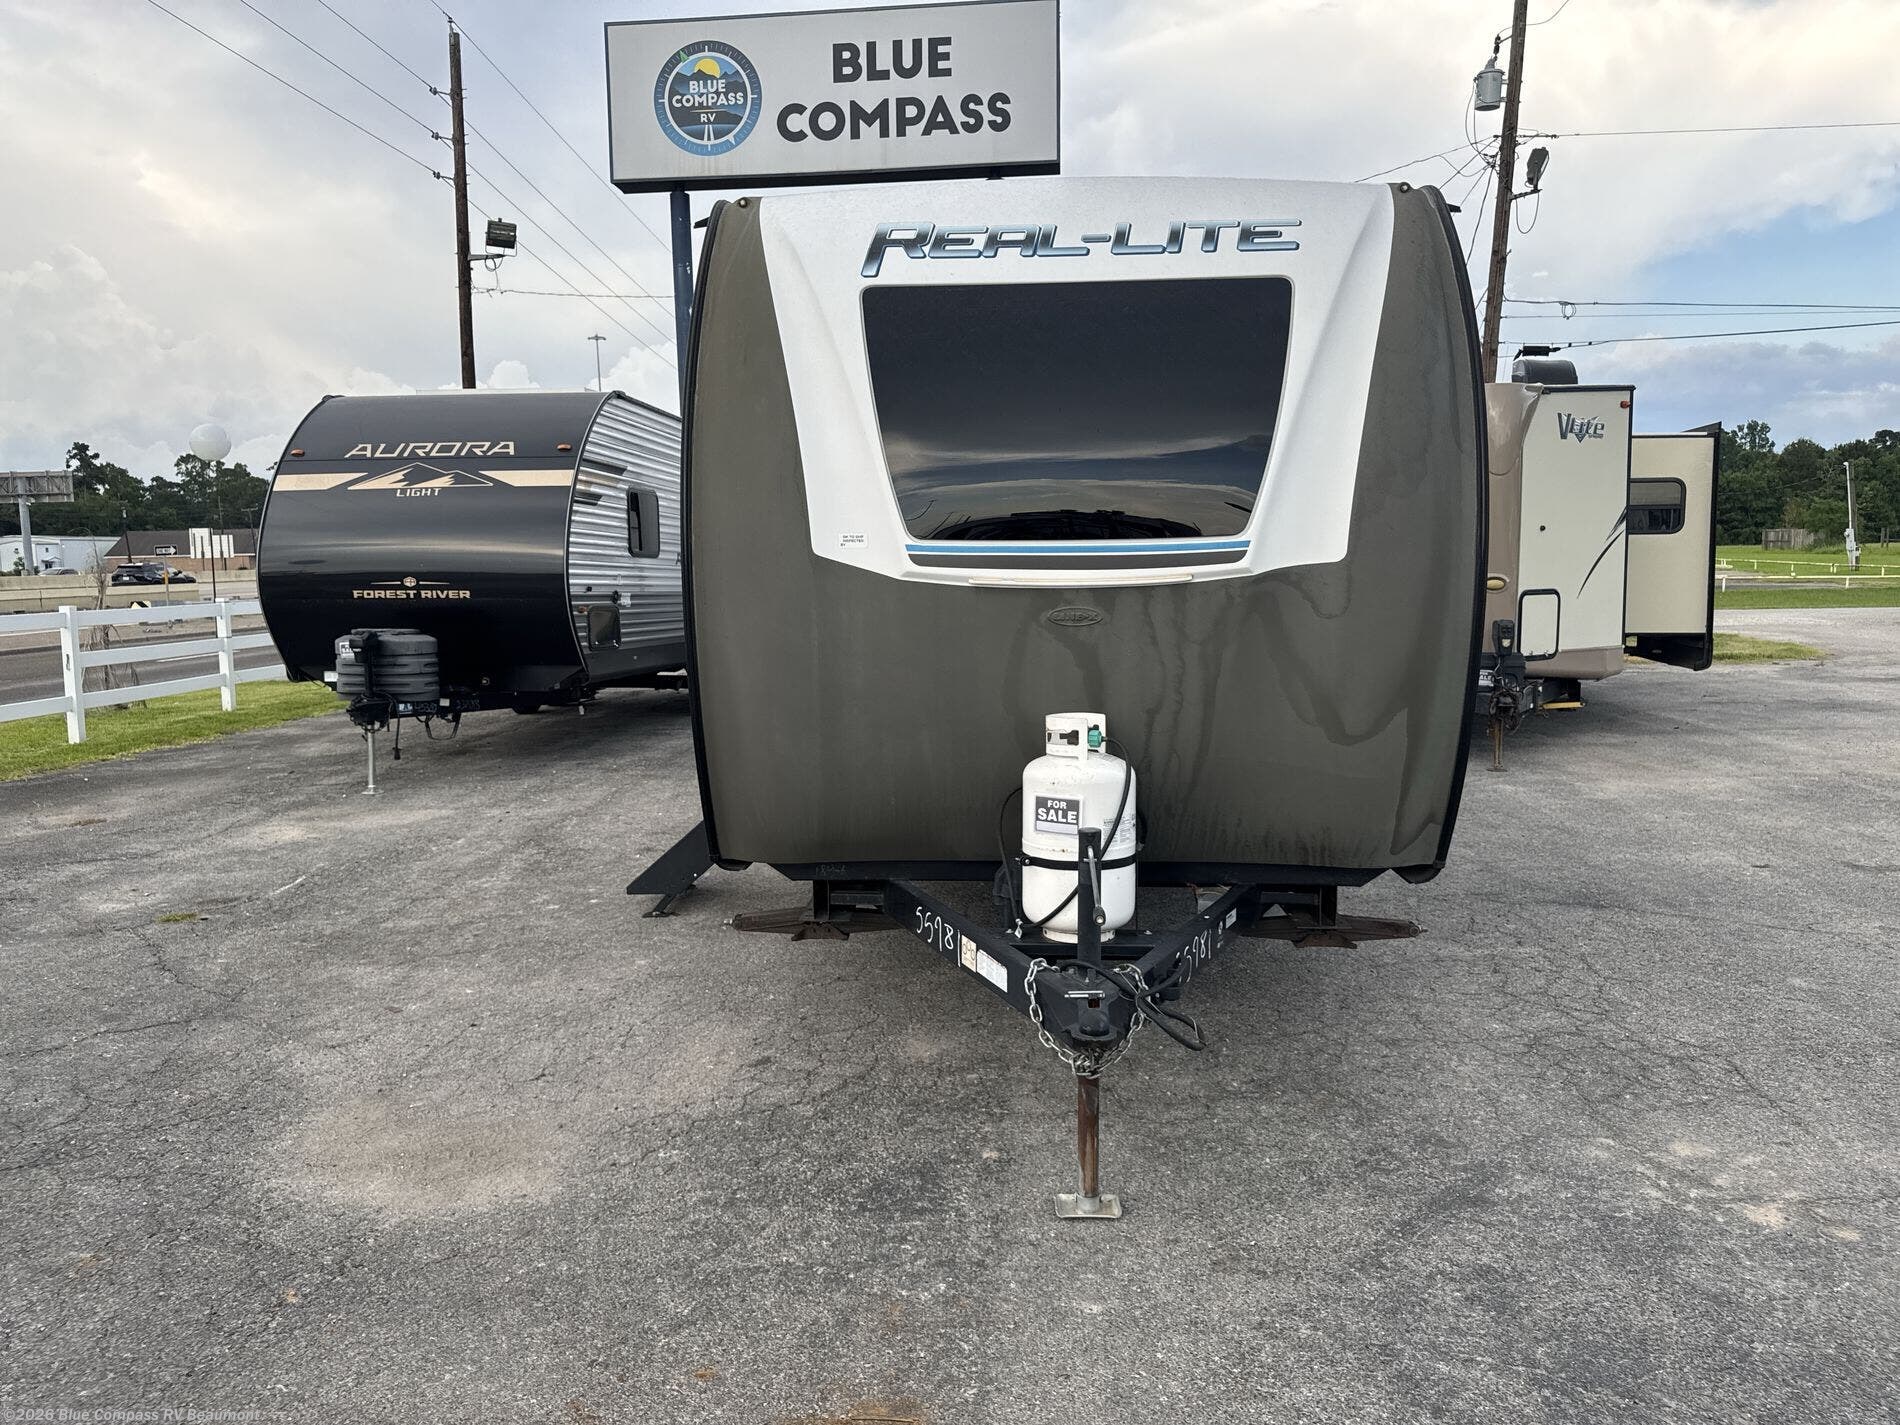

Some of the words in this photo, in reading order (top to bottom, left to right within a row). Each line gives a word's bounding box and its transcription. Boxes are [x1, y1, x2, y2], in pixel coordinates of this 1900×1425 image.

[832, 37, 952, 83] BLUE
[689, 79, 726, 93] BLUE
[672, 93, 744, 107] COMPASS
[700, 113, 716, 122] RV
[777, 92, 1011, 142] COMPASS
[343, 441, 515, 458] AURORA
[396, 487, 442, 497] LIGHT
[352, 590, 417, 599] FOREST
[420, 590, 471, 599] RIVER
[1047, 799, 1068, 809] FOR
[1037, 807, 1077, 824] SALE
